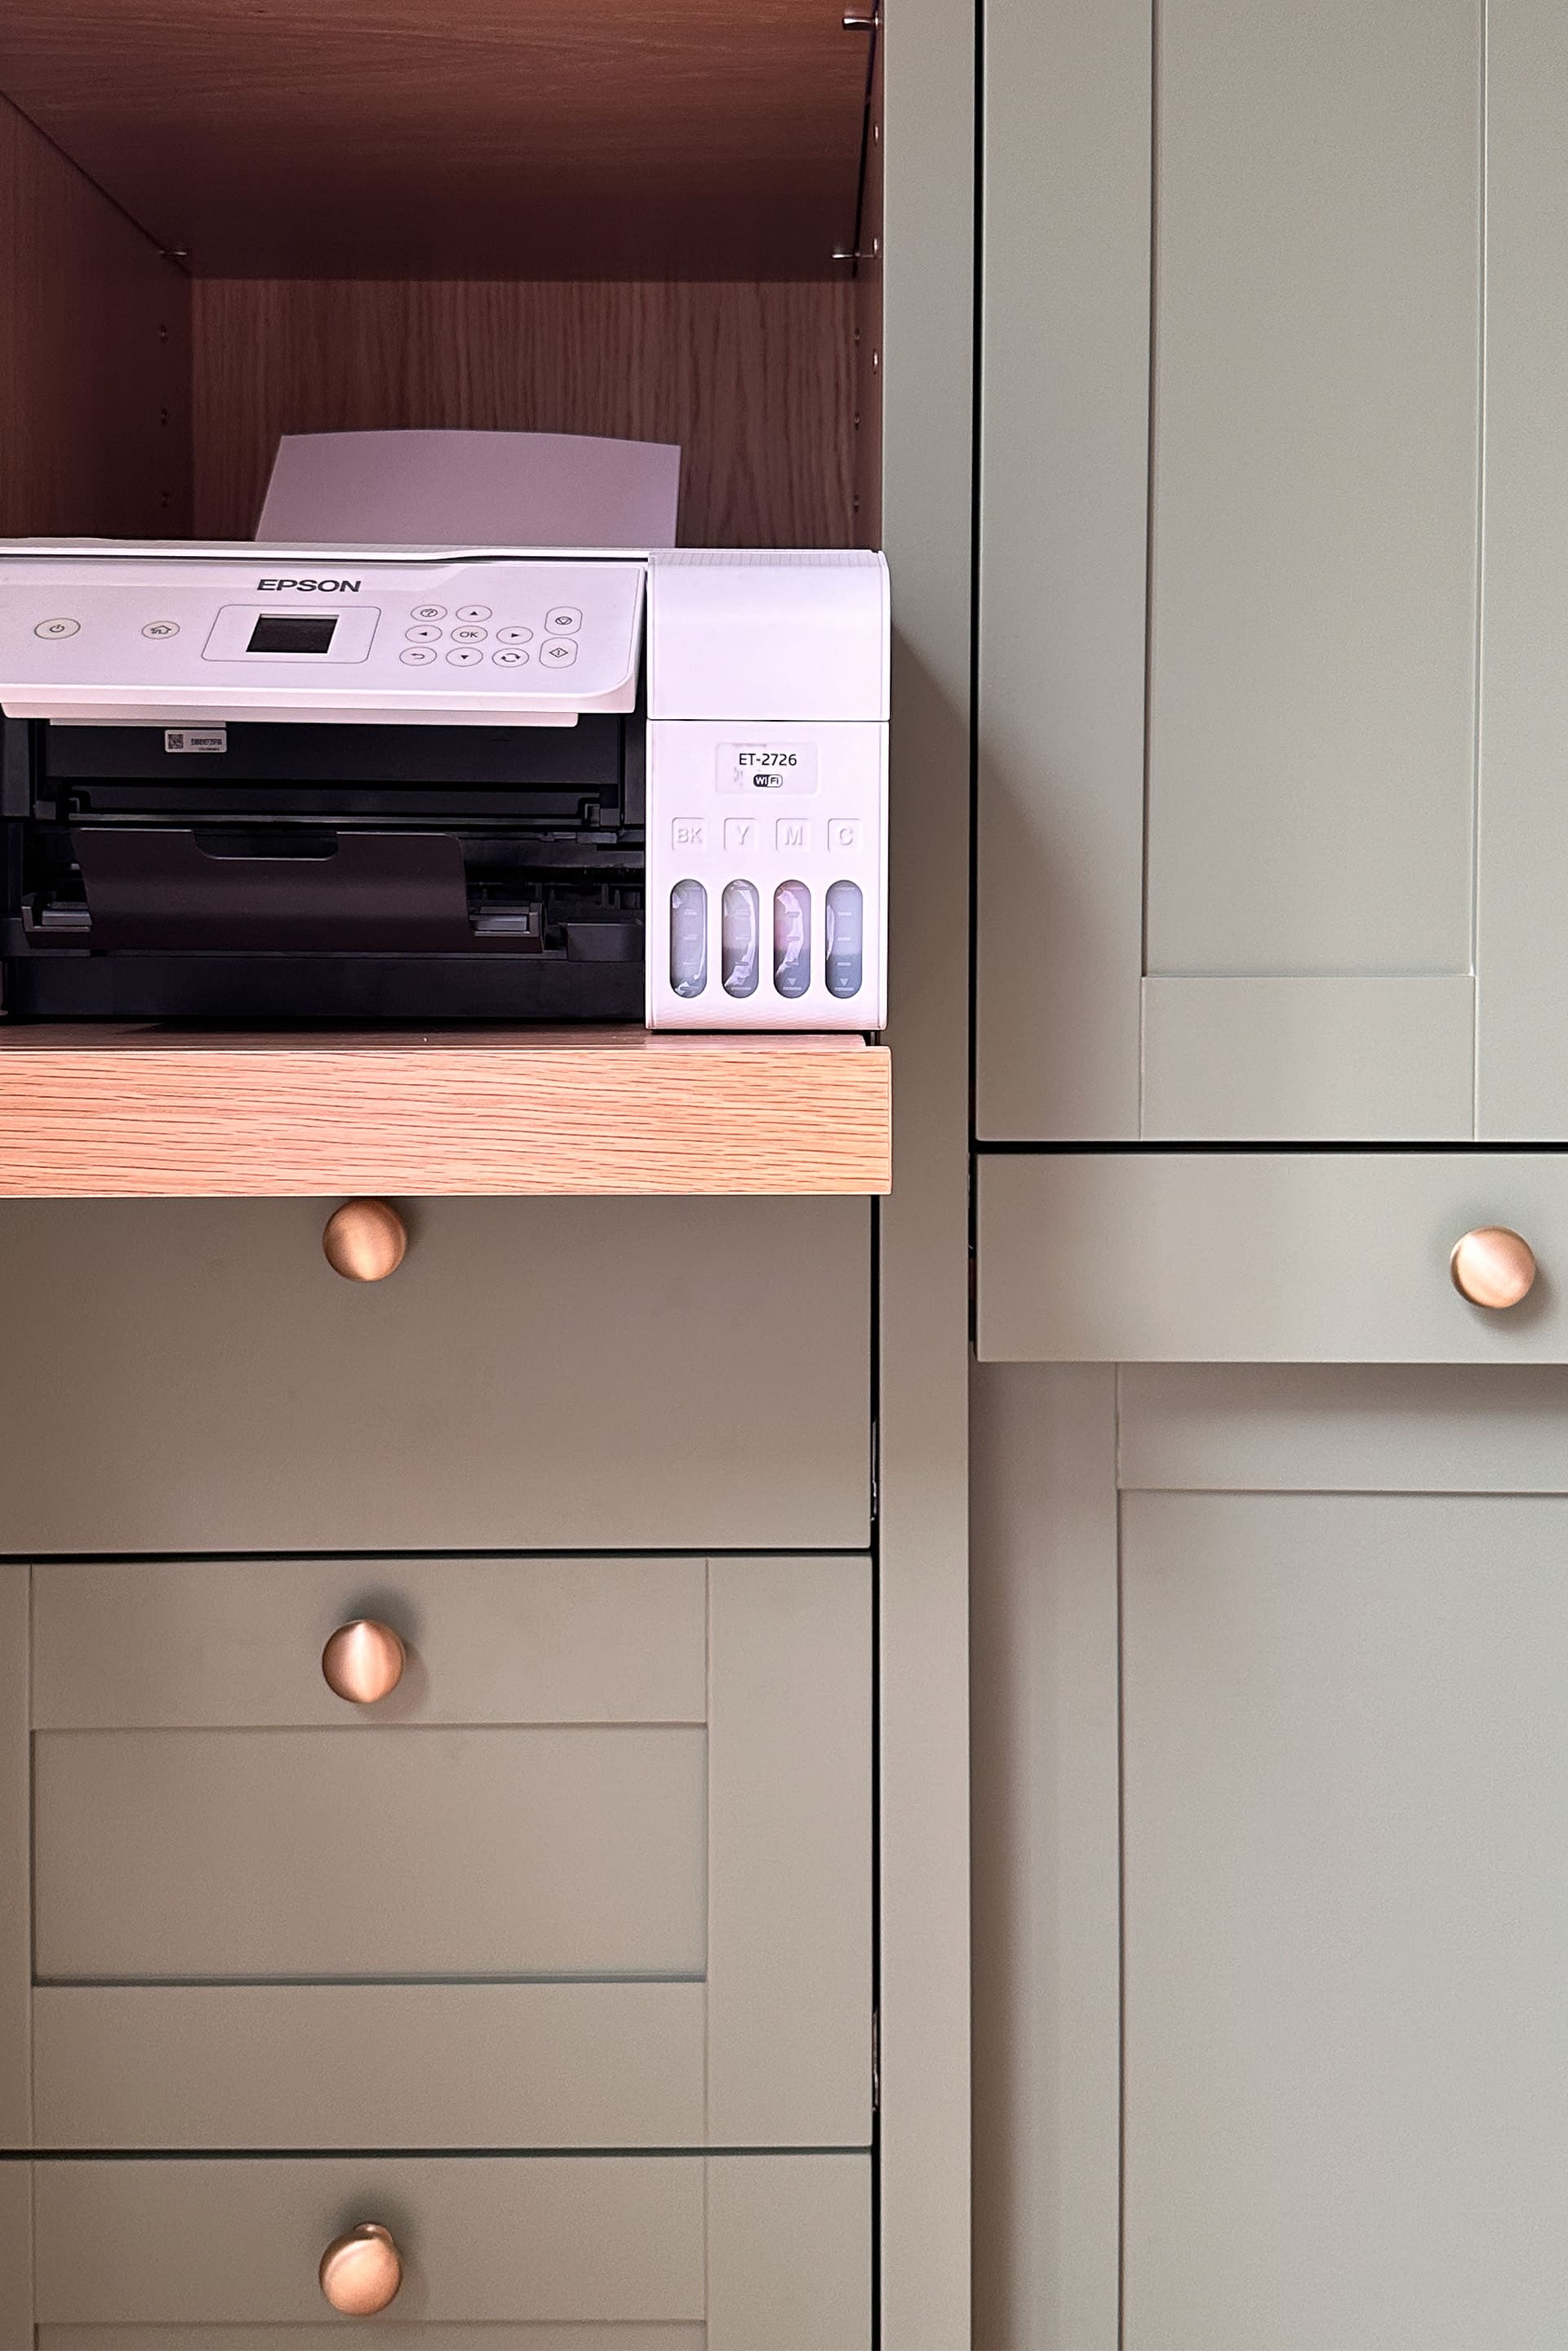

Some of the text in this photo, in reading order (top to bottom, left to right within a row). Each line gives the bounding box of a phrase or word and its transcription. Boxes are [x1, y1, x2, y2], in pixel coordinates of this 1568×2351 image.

[256, 579, 362, 593] EPSON
[739, 753, 797, 767] ET-2726
[677, 827, 703, 843] BK
[736, 824, 750, 846] Y
[784, 824, 804, 846] M
[838, 827, 854, 846] C
